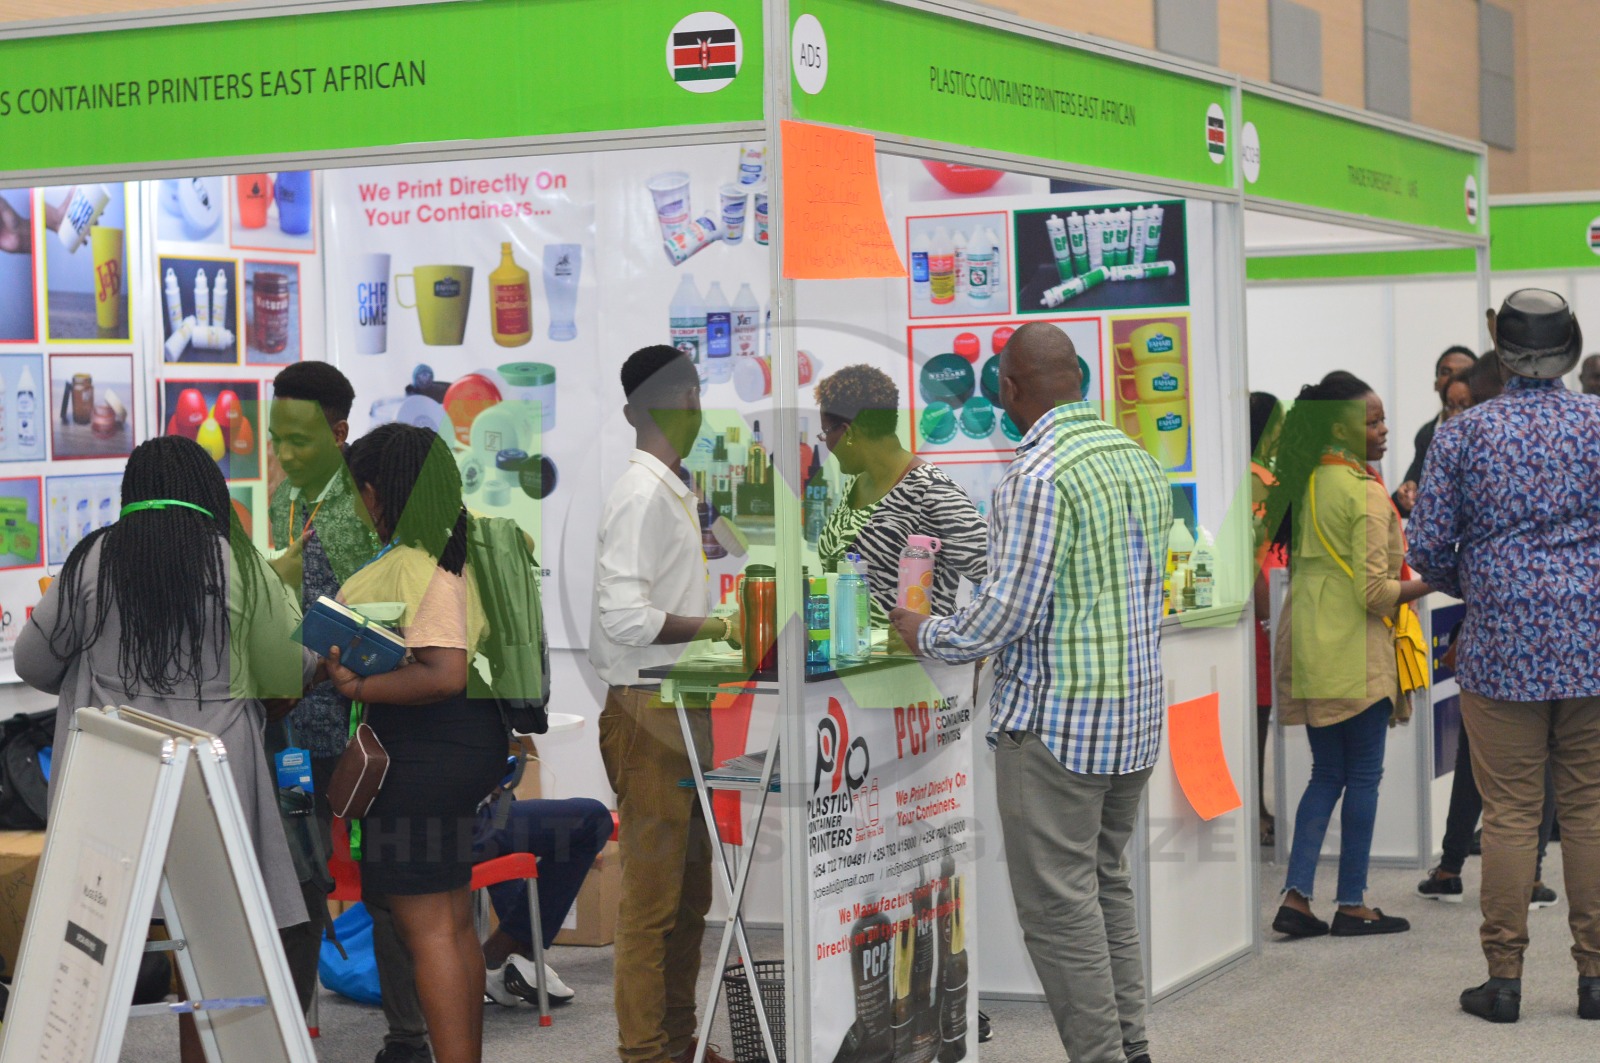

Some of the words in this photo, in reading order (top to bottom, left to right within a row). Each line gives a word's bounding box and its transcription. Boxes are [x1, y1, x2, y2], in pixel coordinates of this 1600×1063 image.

[800, 43, 822, 69] AD5
[17, 81, 141, 115] CONTAINER
[148, 72, 253, 105] PRINTERS
[260, 68, 317, 97] EAST
[323, 60, 426, 93] AFRICAN
[929, 66, 976, 99] PLASTICS
[979, 76, 1033, 108] CONTAINER
[1035, 86, 1076, 116] PRINTERS
[1078, 94, 1099, 119] EAST
[1101, 99, 1136, 127] AFRICAN
[358, 183, 391, 202] We
[397, 179, 442, 200] Print
[450, 172, 529, 198] Directly
[536, 171, 567, 190] On
[365, 208, 411, 226] Your
[417, 199, 552, 223] Containers...
[357, 282, 388, 305] CHR
[358, 304, 388, 327] OME
[806, 485, 828, 499] PCP
[893, 700, 930, 760] PCP
[895, 790, 909, 808] We
[909, 783, 928, 803] Print
[928, 776, 954, 797] Directly
[955, 772, 967, 788] On
[807, 792, 848, 820] PLASTIC
[897, 810, 915, 827] Your
[838, 851, 867, 870] 710481
[838, 907, 852, 925] We
[853, 889, 913, 918] Manufacture
[817, 934, 852, 961] Directly
[862, 941, 888, 981] PCP
